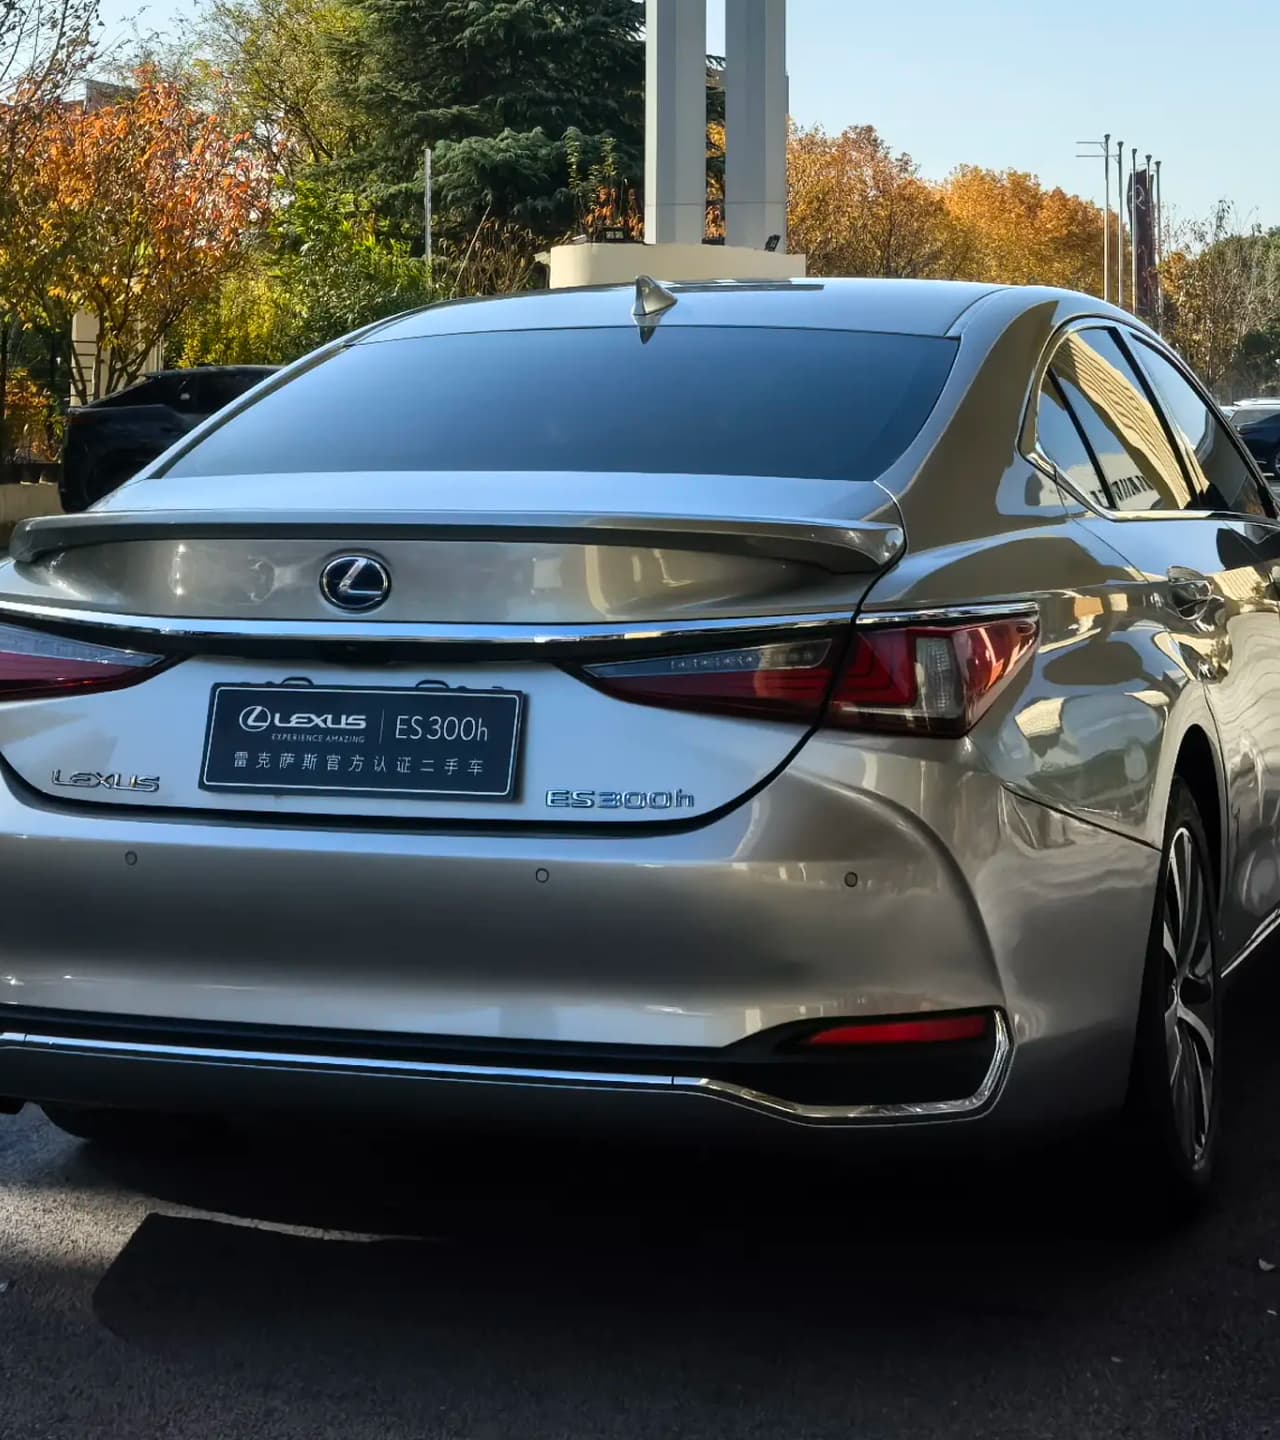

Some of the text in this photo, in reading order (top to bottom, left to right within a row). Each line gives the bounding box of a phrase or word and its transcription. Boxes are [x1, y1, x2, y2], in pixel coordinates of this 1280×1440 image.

[273, 712, 367, 730] LEXUS
[271, 733, 366, 744] EXPERIENCE AMAZING
[233, 750, 485, 777] 雷克萨斯官方认证二手车
[51, 769, 161, 793] LEXUS
[545, 788, 695, 810] ES300h
